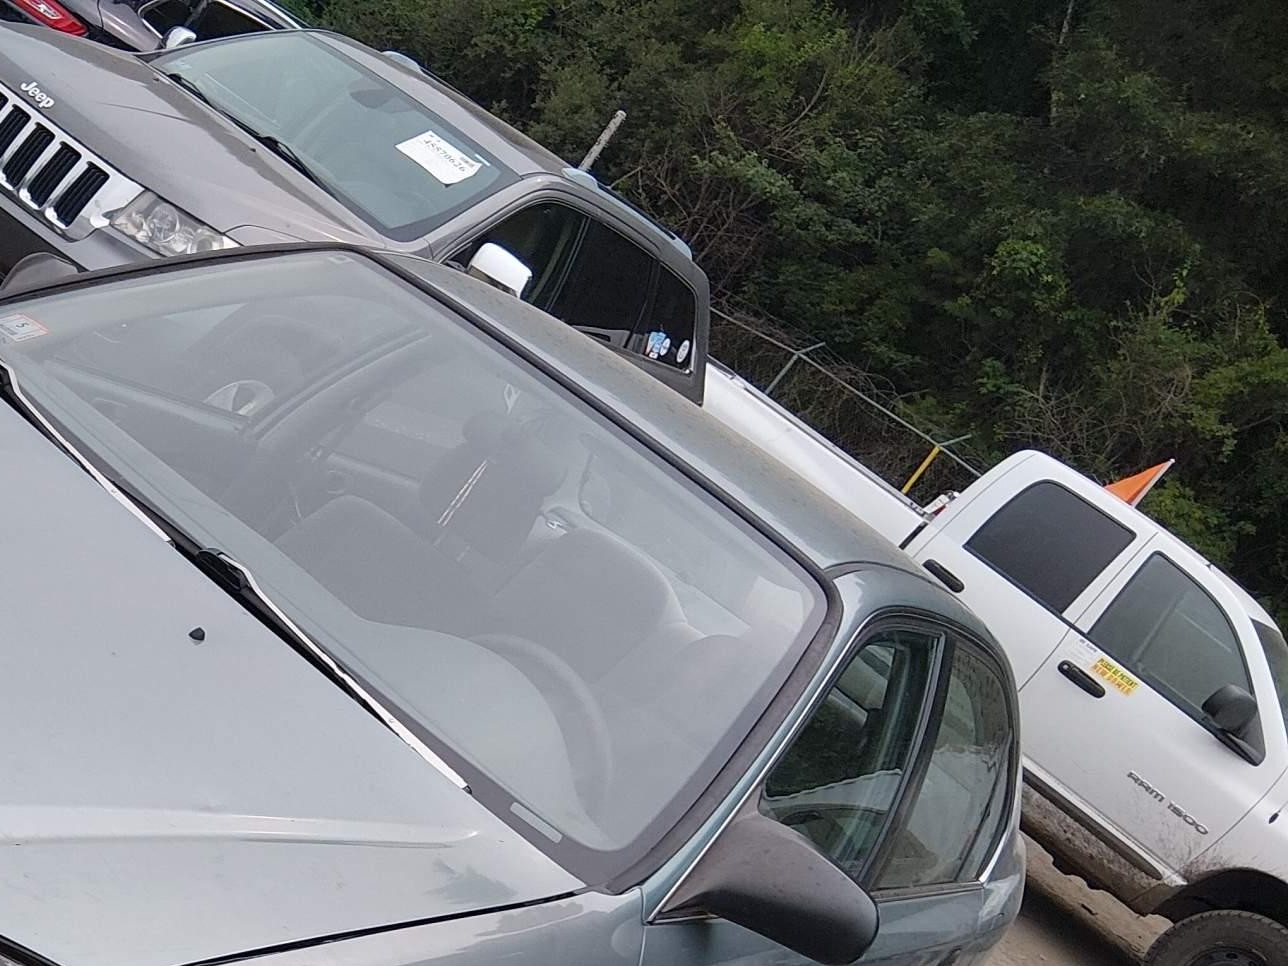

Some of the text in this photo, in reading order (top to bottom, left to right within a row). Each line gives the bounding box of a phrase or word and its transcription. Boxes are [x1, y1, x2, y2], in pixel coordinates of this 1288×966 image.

[20, 81, 55, 108] Jeep
[1127, 770, 1209, 835] RAM 1500
